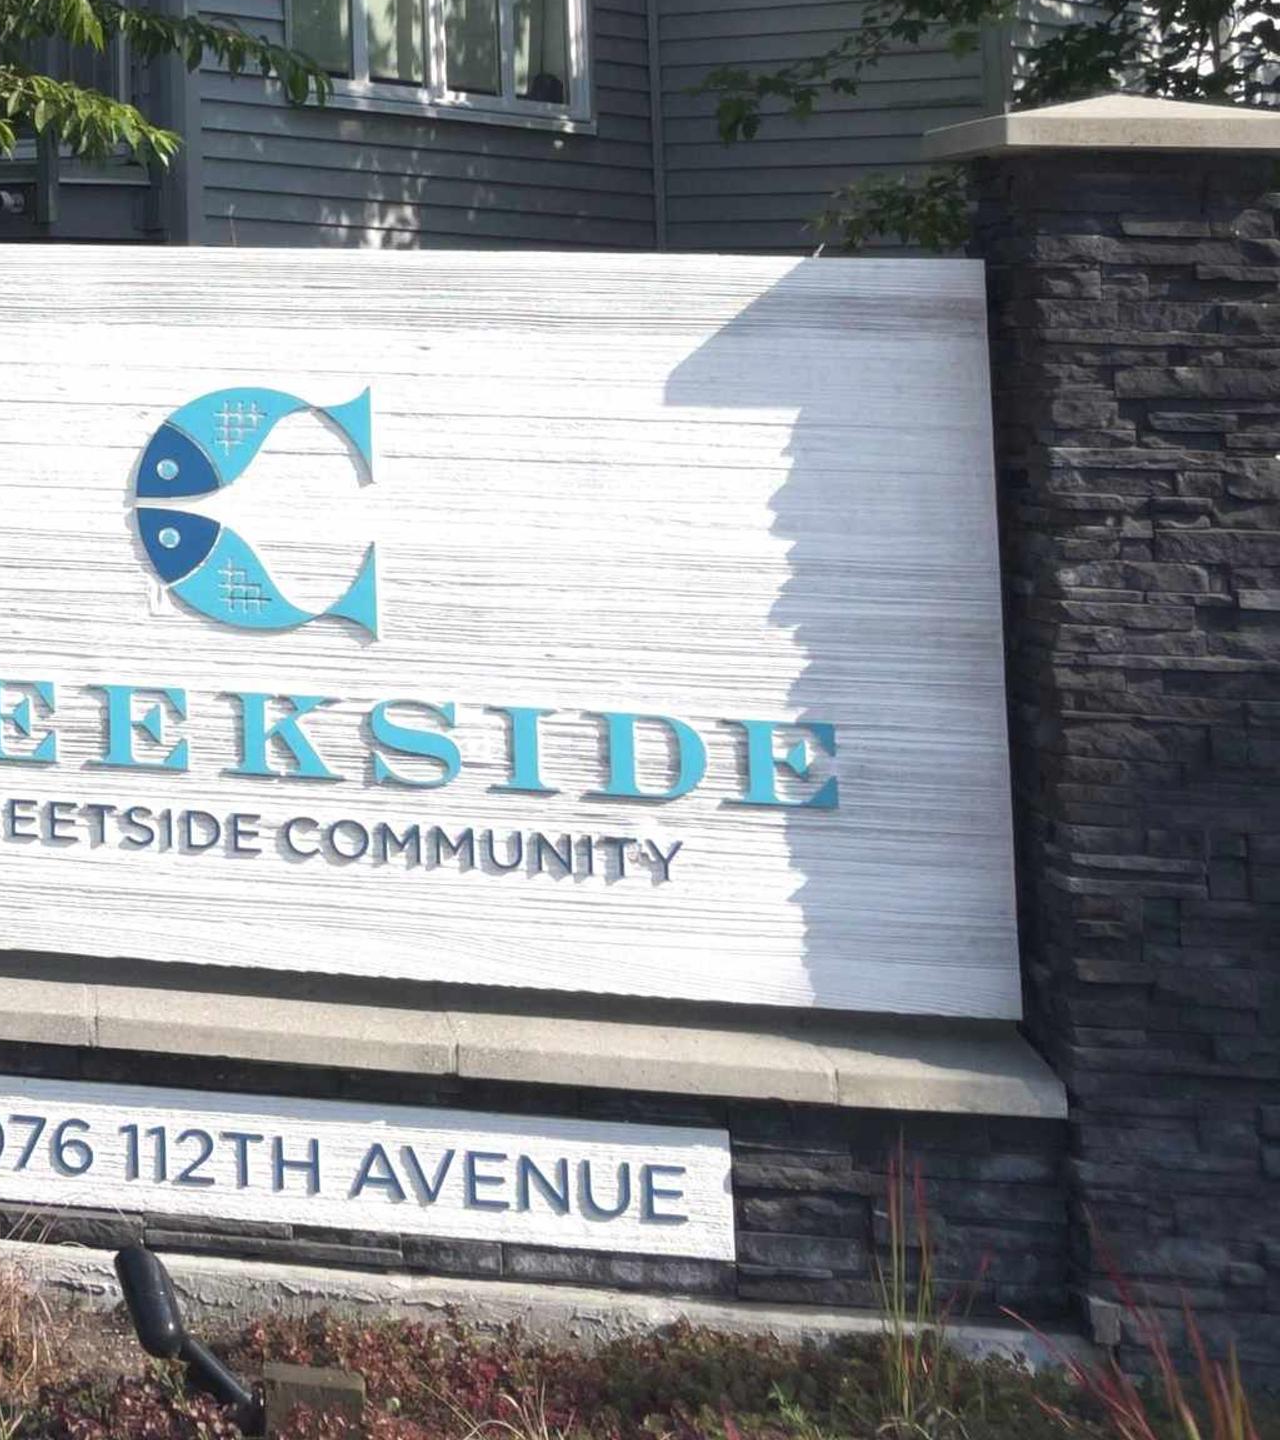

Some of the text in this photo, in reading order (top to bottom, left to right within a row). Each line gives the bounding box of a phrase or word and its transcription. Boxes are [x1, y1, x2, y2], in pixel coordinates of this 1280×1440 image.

[281, 816, 683, 882] COMMUNITY
[119, 1122, 321, 1196] 112TH
[347, 1141, 689, 1225] AVENUE
